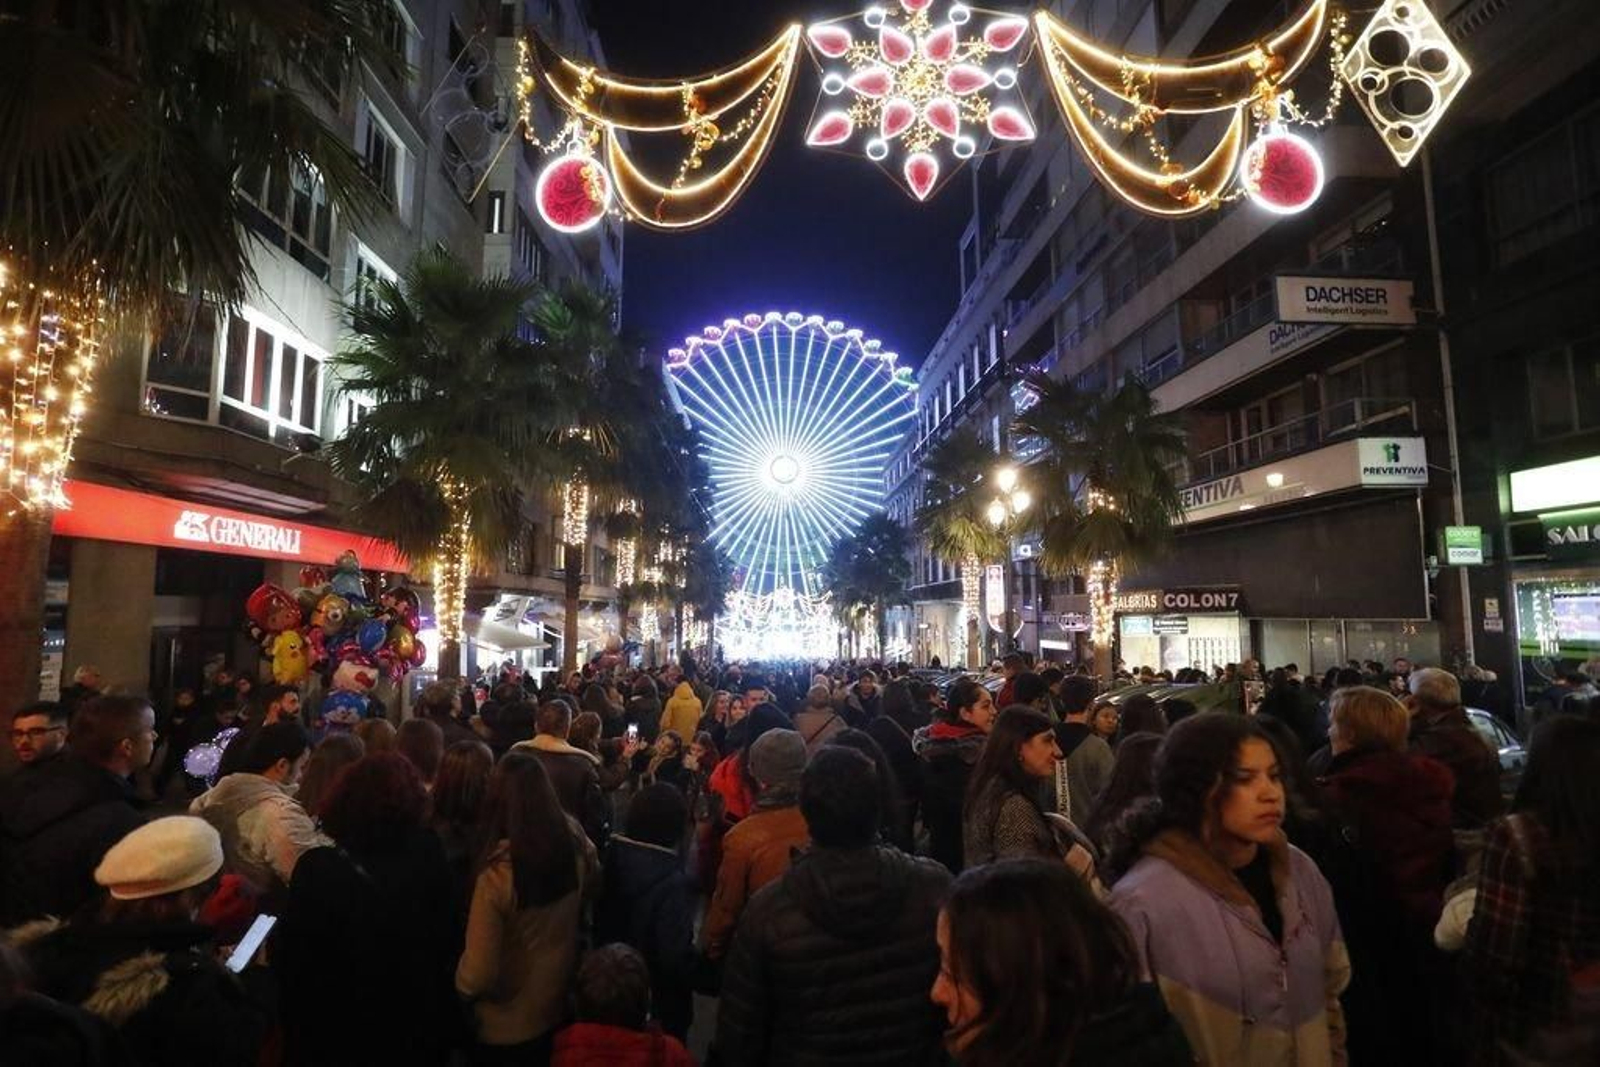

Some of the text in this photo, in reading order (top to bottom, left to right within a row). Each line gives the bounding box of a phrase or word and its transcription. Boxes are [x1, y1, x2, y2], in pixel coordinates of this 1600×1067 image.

[1305, 286, 1388, 304] DACHSER
[1306, 305, 1388, 316] Intelligent Logistics
[1269, 324, 1306, 345] DACH
[1363, 466, 1426, 476] PREVENTIVA
[210, 516, 302, 555] GENERALI
